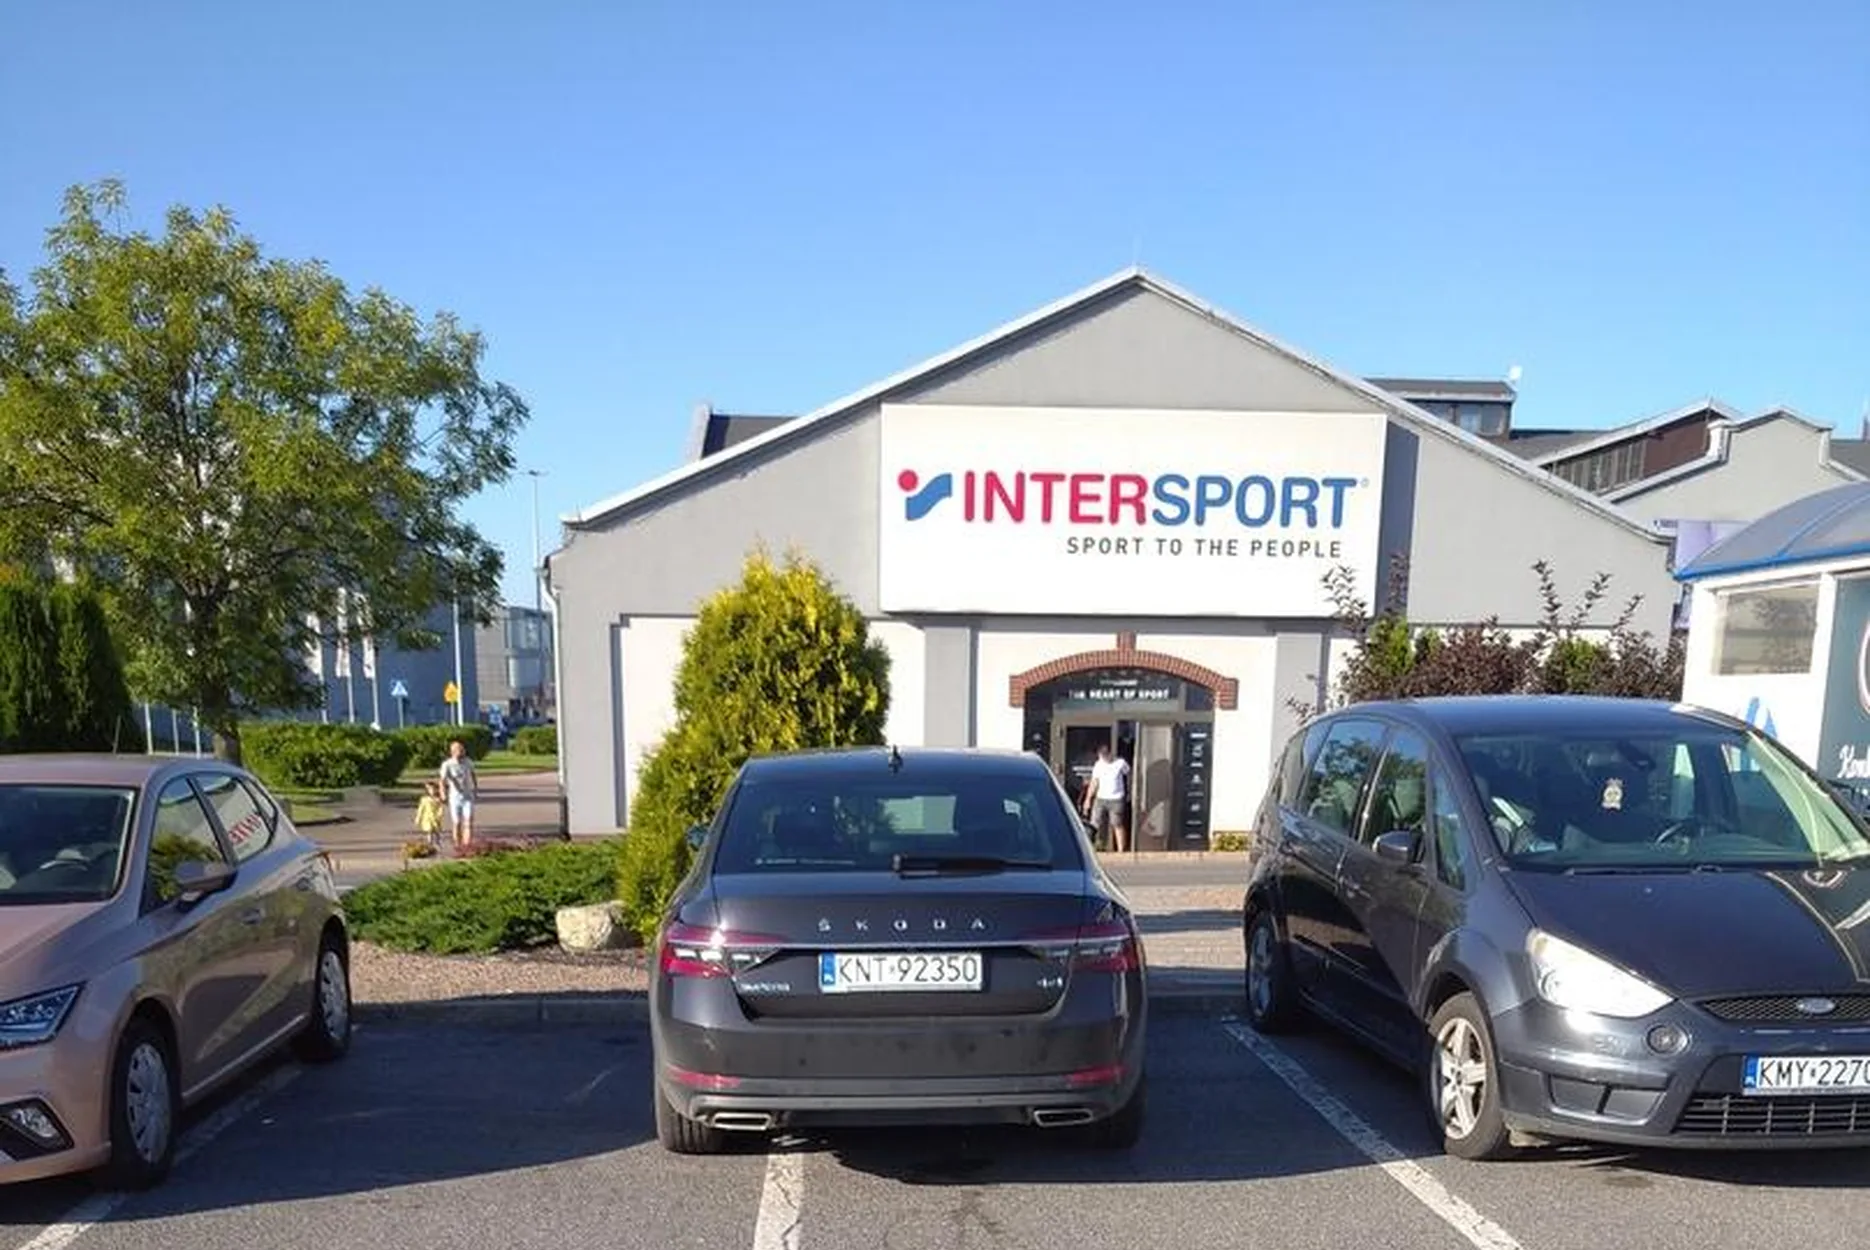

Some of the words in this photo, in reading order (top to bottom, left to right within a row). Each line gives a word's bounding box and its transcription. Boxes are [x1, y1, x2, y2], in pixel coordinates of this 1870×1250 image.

[963, 470, 1358, 529] INTERSPORT
[1066, 536, 1144, 555] SPORT
[1156, 538, 1183, 556] TO
[1195, 538, 1239, 556] THE
[1250, 539, 1342, 558] PEOPLE
[838, 956, 887, 983] KNT
[897, 955, 978, 983] 92350
[1759, 1059, 1809, 1086] KMY
